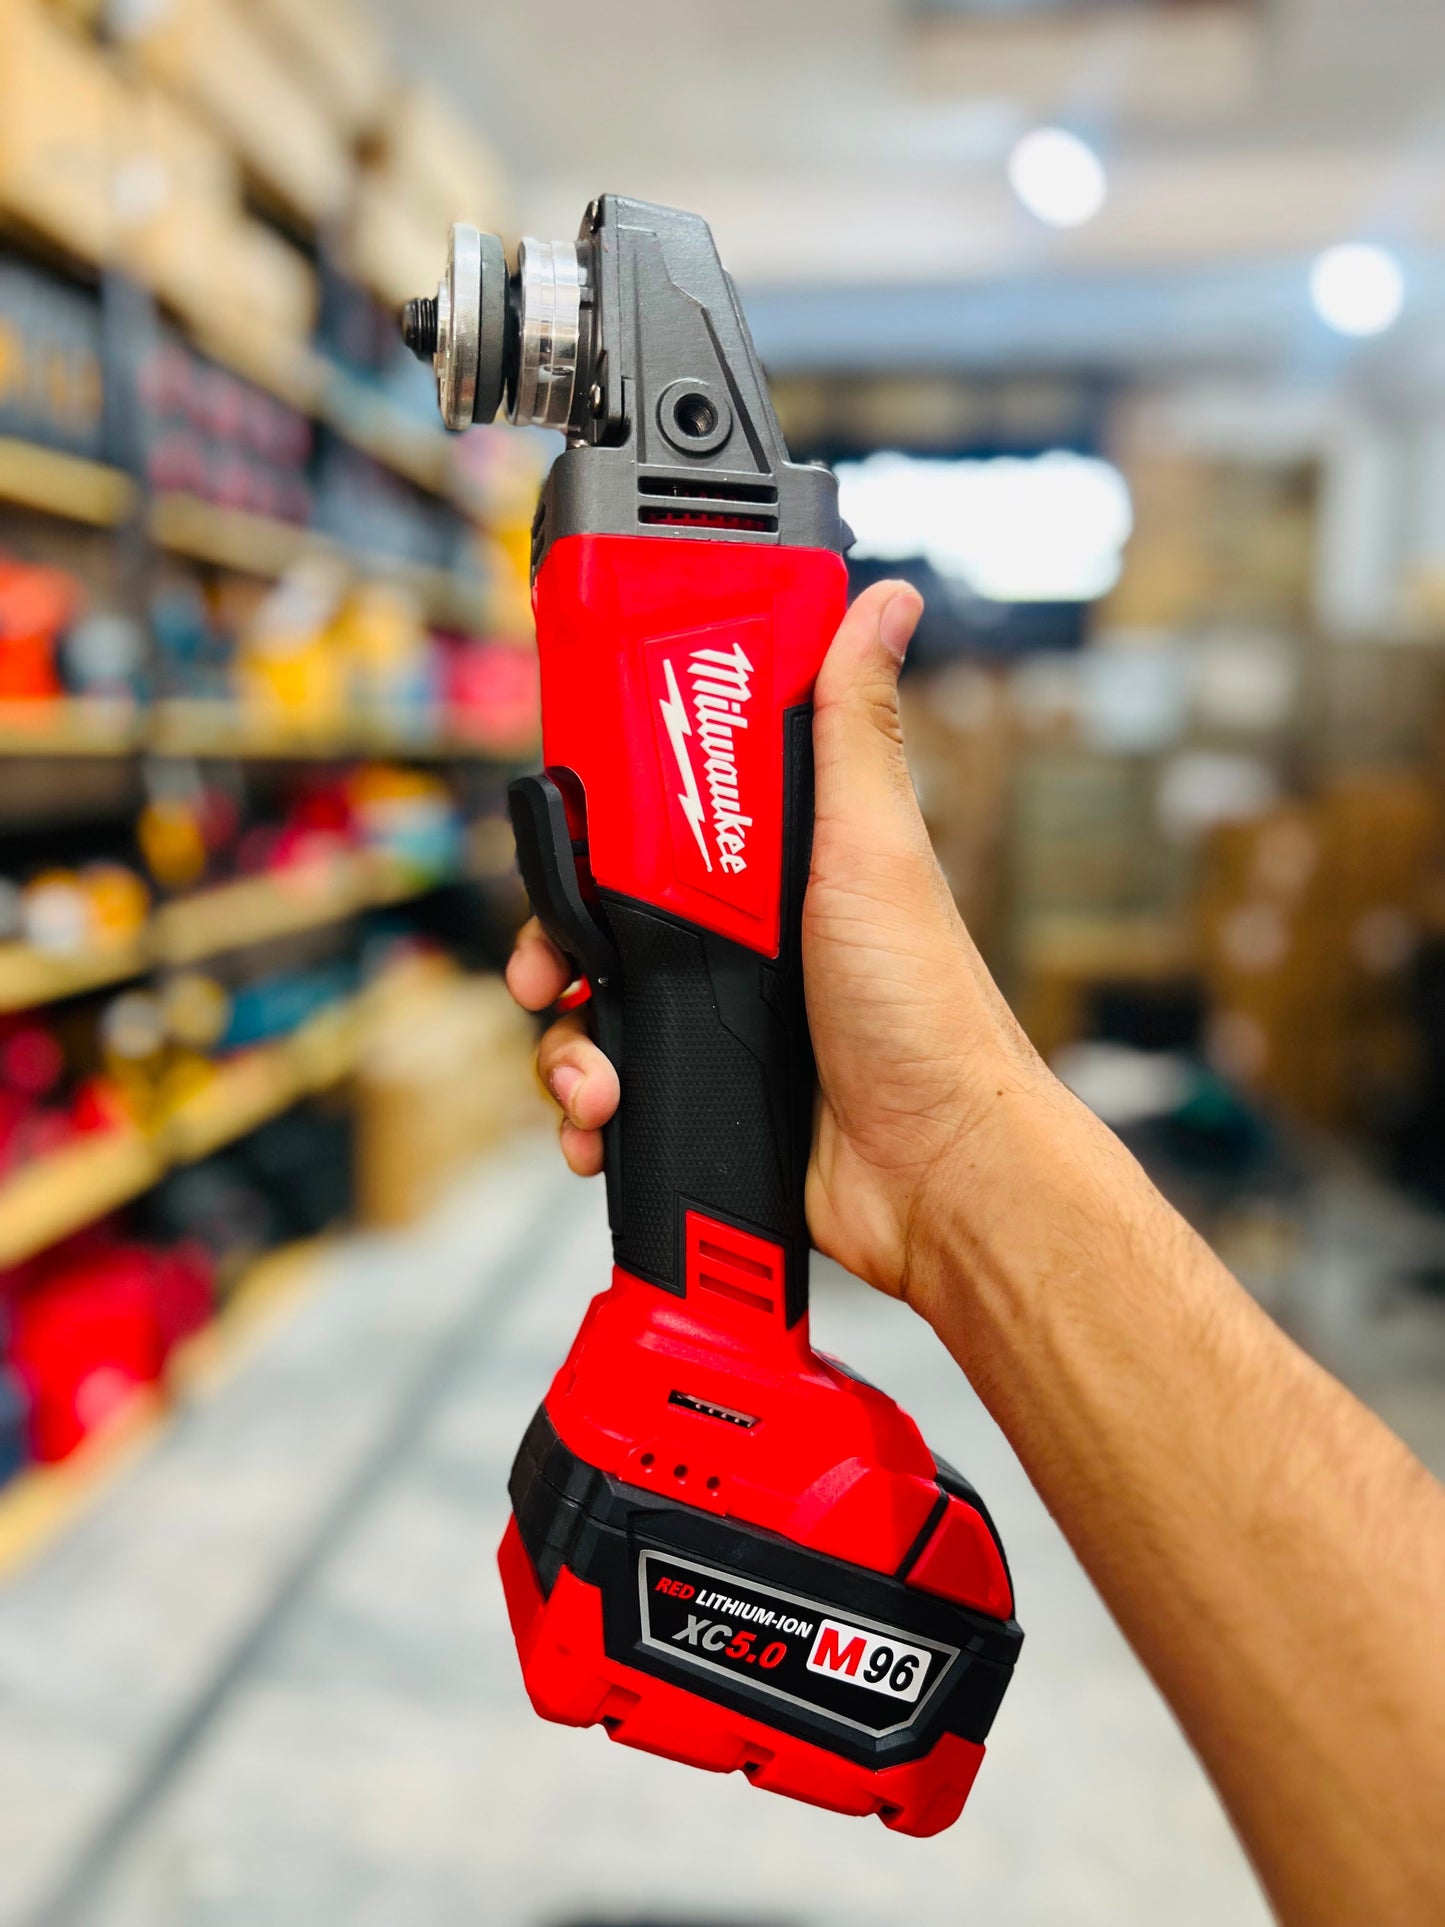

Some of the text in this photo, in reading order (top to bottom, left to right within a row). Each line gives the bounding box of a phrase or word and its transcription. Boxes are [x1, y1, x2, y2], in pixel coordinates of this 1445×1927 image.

[687, 643, 754, 874] Milwaukee
[655, 1577, 813, 1638] RED LITHIUM-ION
[672, 1614, 787, 1669] XC5.0
[812, 1628, 920, 1692] M96
